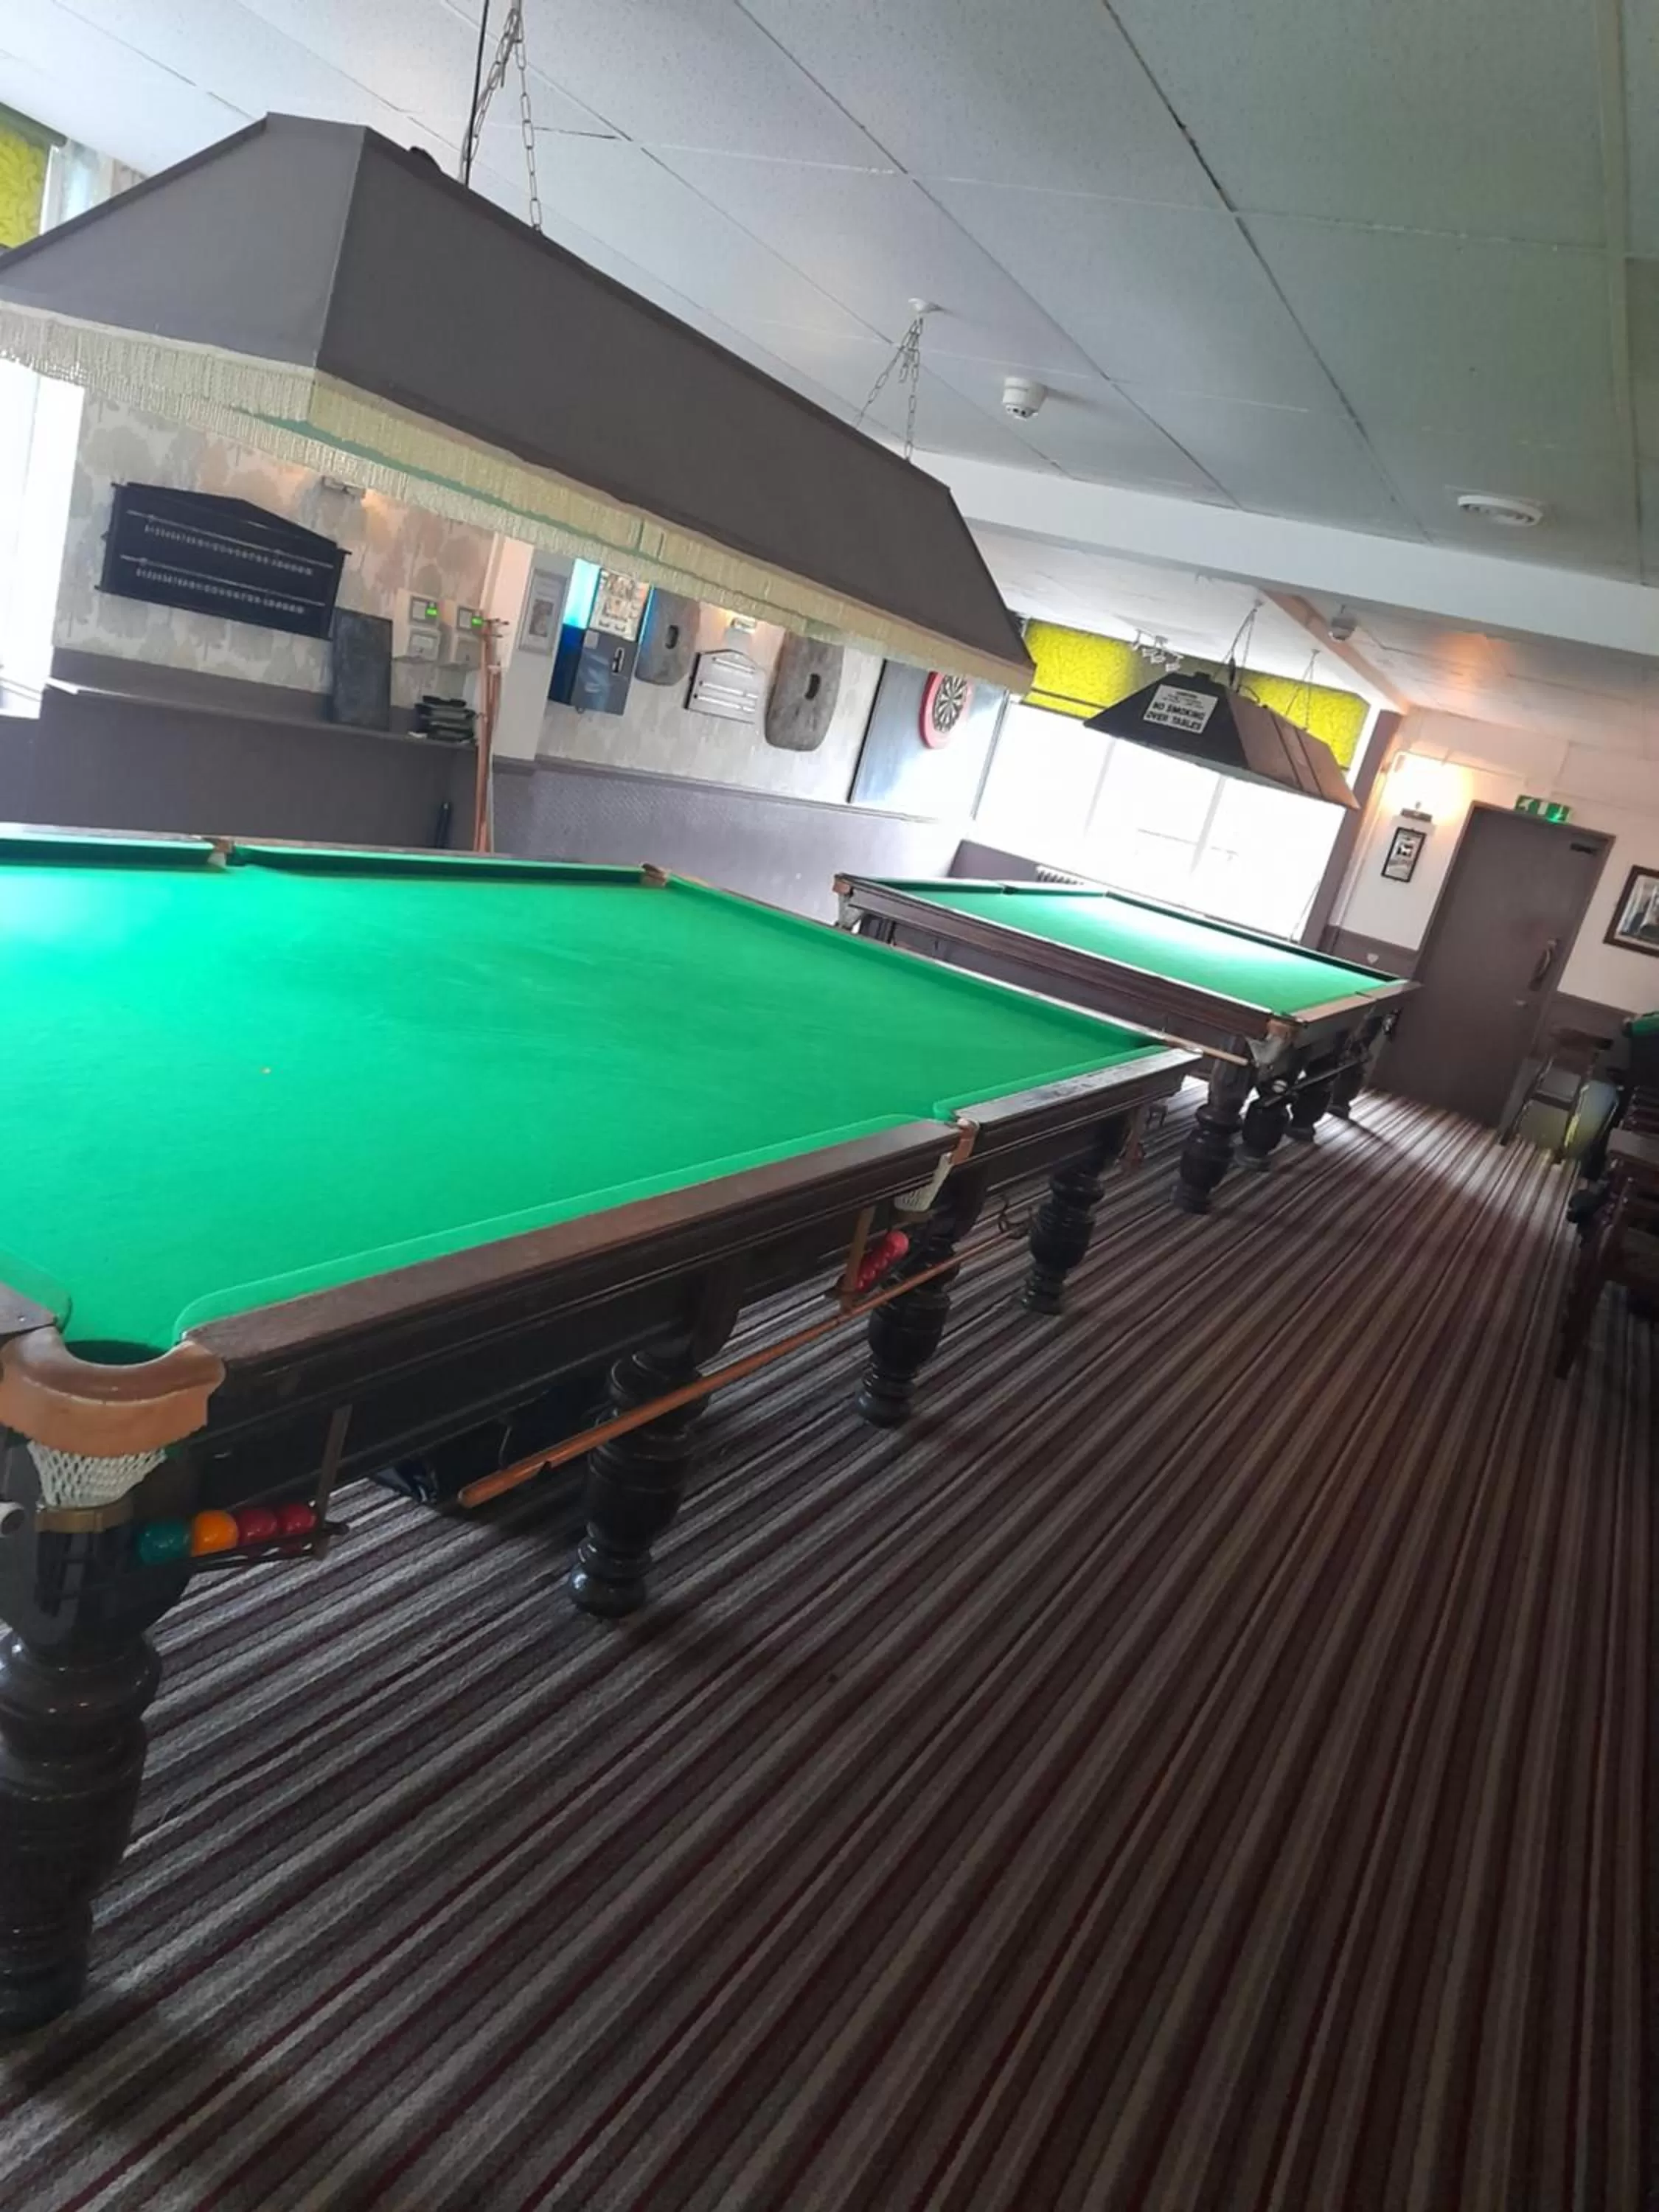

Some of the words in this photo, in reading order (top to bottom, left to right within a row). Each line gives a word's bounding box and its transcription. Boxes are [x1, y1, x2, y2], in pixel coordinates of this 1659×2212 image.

[1147, 711, 1169, 721] OVER
[1152, 701, 1165, 710] NO
[1166, 704, 1206, 720] SMOKING
